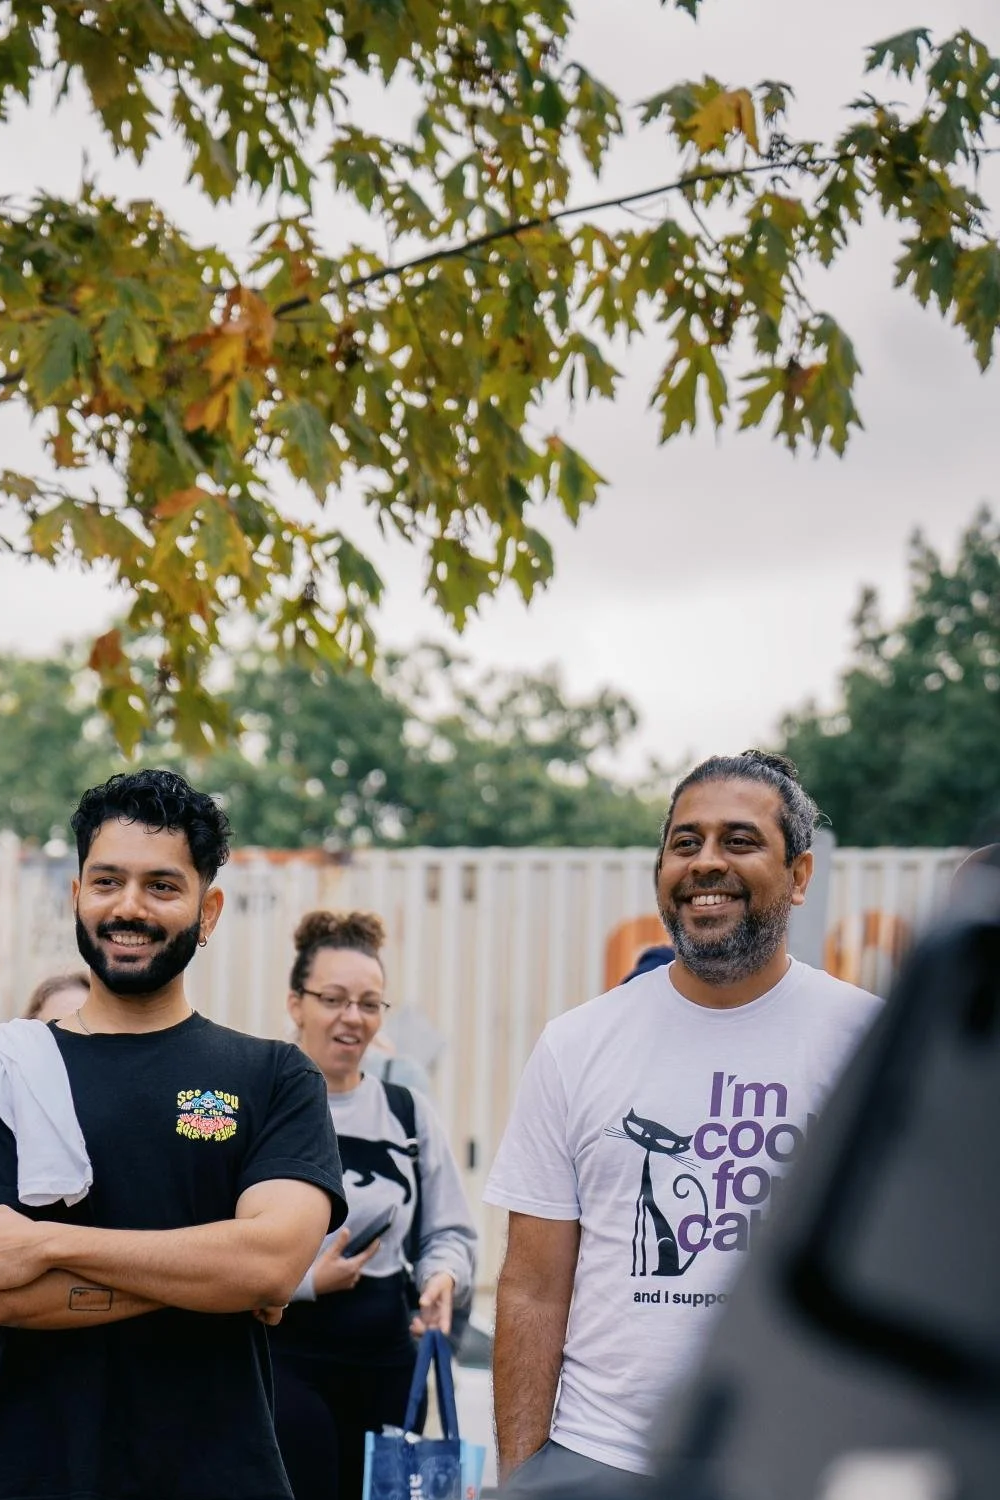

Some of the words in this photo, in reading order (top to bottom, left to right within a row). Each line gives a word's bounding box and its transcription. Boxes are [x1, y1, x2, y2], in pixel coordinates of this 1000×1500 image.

[709, 1071, 789, 1118] I'm
[677, 1209, 761, 1253] ca
[633, 1289, 661, 1304] and
[664, 1290, 669, 1304] I
[672, 1292, 728, 1308] suppo
